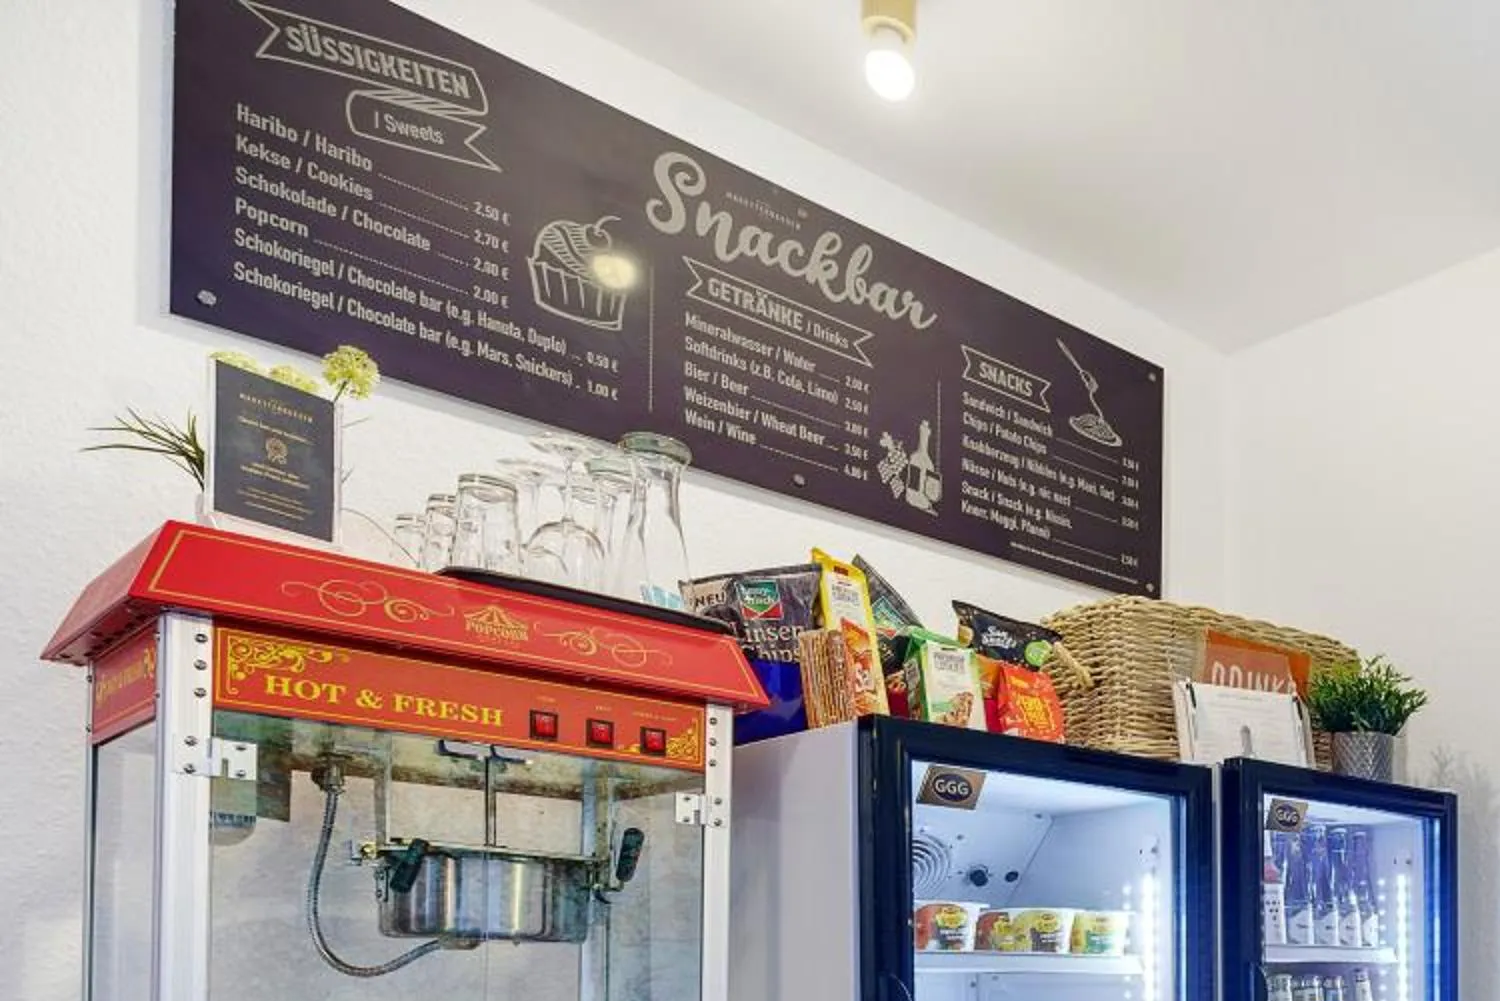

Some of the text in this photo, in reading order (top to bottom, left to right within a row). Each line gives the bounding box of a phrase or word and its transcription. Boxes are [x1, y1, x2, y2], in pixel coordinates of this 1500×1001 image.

[286, 23, 471, 99] SÜSSIGKEITEN
[237, 103, 298, 142] Haribo
[315, 134, 373, 172] Haribo
[384, 113, 444, 145] Sweets
[236, 134, 291, 169] Kekse
[307, 161, 373, 201] Cookies
[235, 166, 337, 217] Schokolade
[353, 209, 431, 251] Chocolate
[235, 197, 309, 238] Popcorn
[646, 151, 938, 329] Snackbar
[234, 227, 335, 277] Schokoriegel
[348, 265, 416, 304] Chocolate
[419, 286, 441, 313] bar
[233, 261, 335, 310] Schokoriegel
[347, 299, 416, 336] Chocolate
[419, 322, 441, 343] bar
[515, 353, 573, 389] Snickers)
[685, 310, 773, 358] Mineralwasser
[707, 275, 804, 331] GETRÄNKE
[813, 323, 849, 349] Drinks
[685, 336, 747, 372] Softdrinks
[685, 360, 709, 383] Bier
[721, 374, 749, 397] Beer
[979, 362, 1033, 398] SNACKS
[684, 386, 751, 422] Weizenbier
[761, 411, 797, 436] Wheat
[799, 424, 825, 446] Beer
[685, 408, 715, 434] Wein
[726, 421, 757, 446] Wine
[695, 591, 726, 608] NEU
[264, 674, 503, 727] HOT & FRESH
[935, 779, 969, 796] GGG
